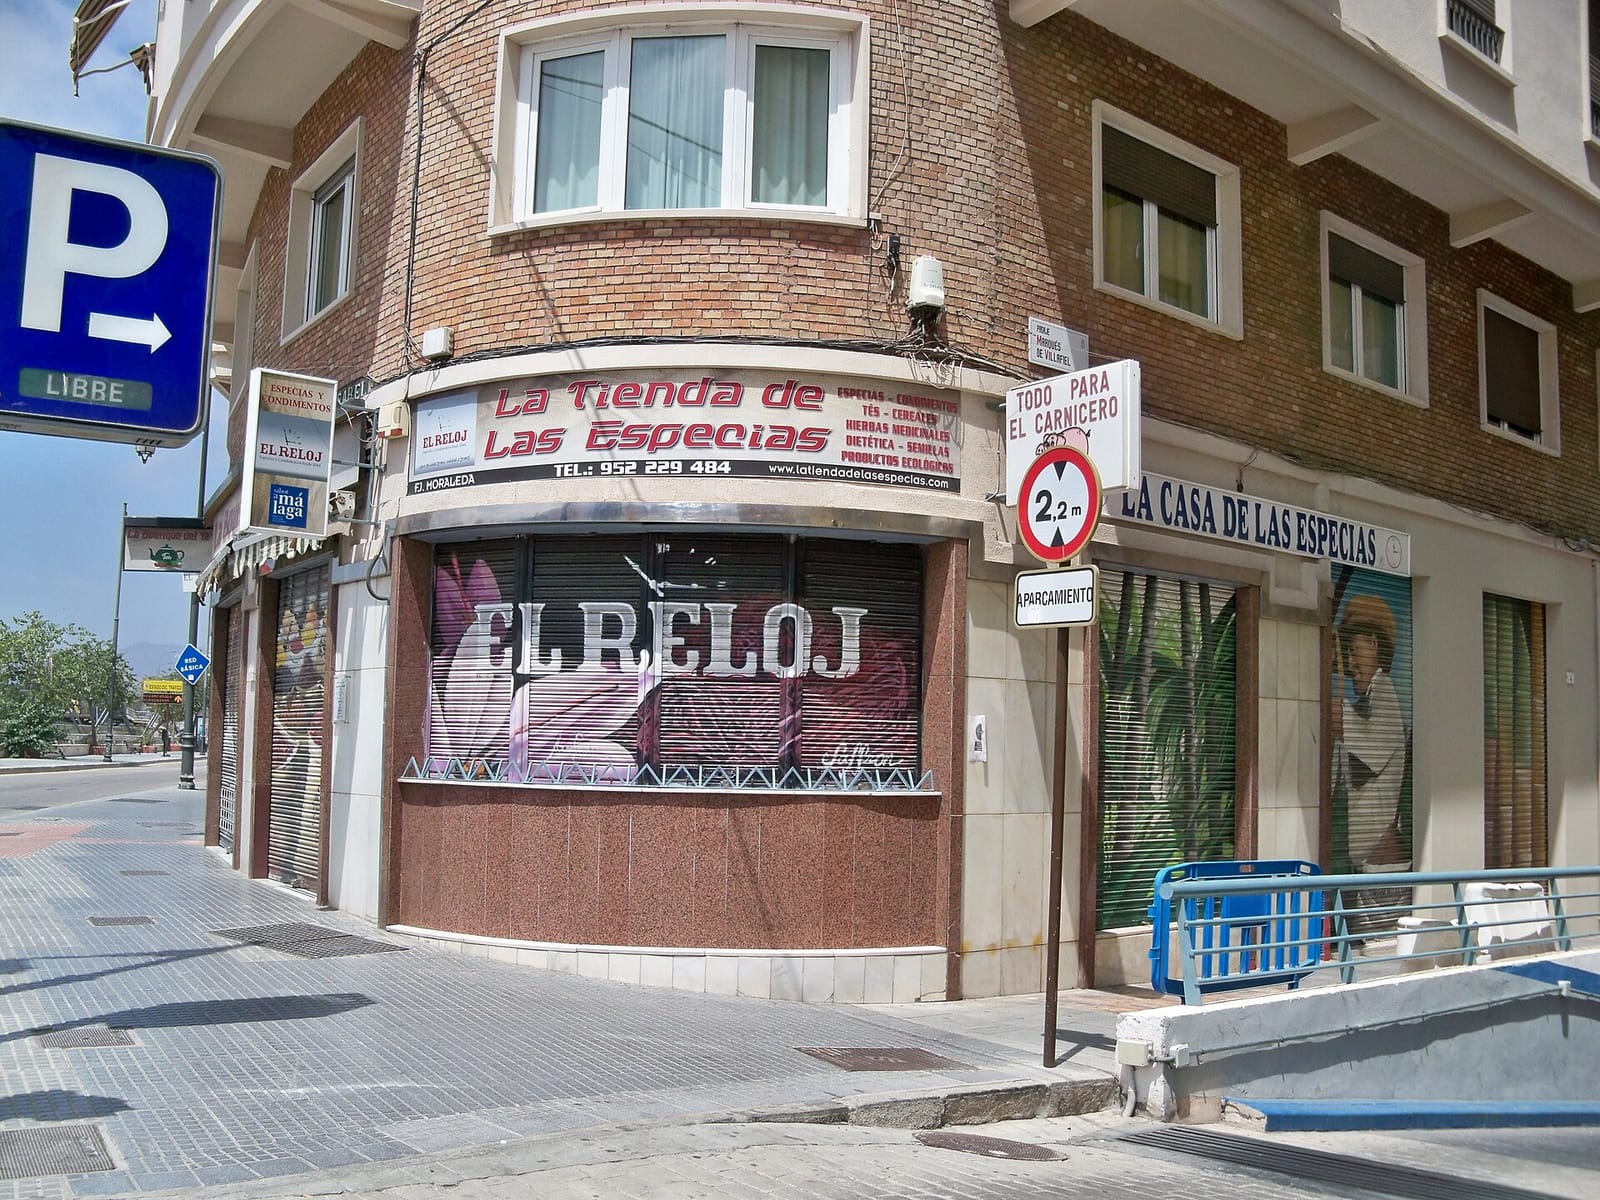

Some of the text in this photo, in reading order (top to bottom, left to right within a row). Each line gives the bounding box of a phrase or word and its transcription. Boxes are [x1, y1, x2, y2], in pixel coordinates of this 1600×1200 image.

[20, 152, 169, 333] P
[46, 373, 125, 404] LIBRE
[271, 384, 325, 400] ESPECIAS Y
[494, 376, 824, 418] La Tienda de
[838, 387, 885, 402] ESPECIAS
[896, 394, 959, 413] CONDIMENTOS
[1016, 370, 1110, 413] TODO PARA
[262, 395, 331, 413] CONDIMENTOS
[862, 403, 880, 417] TÉS
[892, 408, 938, 425] CEREALES
[1009, 395, 1118, 440] EL CARNICERO
[423, 437, 434, 449] EL
[435, 430, 468, 446] RELOJ
[483, 420, 830, 460] Las Especias
[846, 419, 951, 442] HIERBAS MEDICINALES
[260, 443, 277, 456] EL
[279, 446, 323, 462] RELOJ
[846, 434, 895, 450] DIETÉTICA
[907, 441, 949, 457] SEMILLAS
[553, 461, 731, 478] TEL.: 952 229 484
[841, 450, 954, 474] PRODUCTOS ECOLÓGICOS
[426, 474, 475, 491] MORALEDA
[768, 463, 949, 489] www.latiendadelasespecias.com
[1122, 476, 1376, 566] LA CASA DE LAS ESPECIAS
[1017, 586, 1093, 608] APARCAMIENTO
[474, 601, 868, 678] EL RELOJ
[181, 664, 204, 672] BÁSICA
